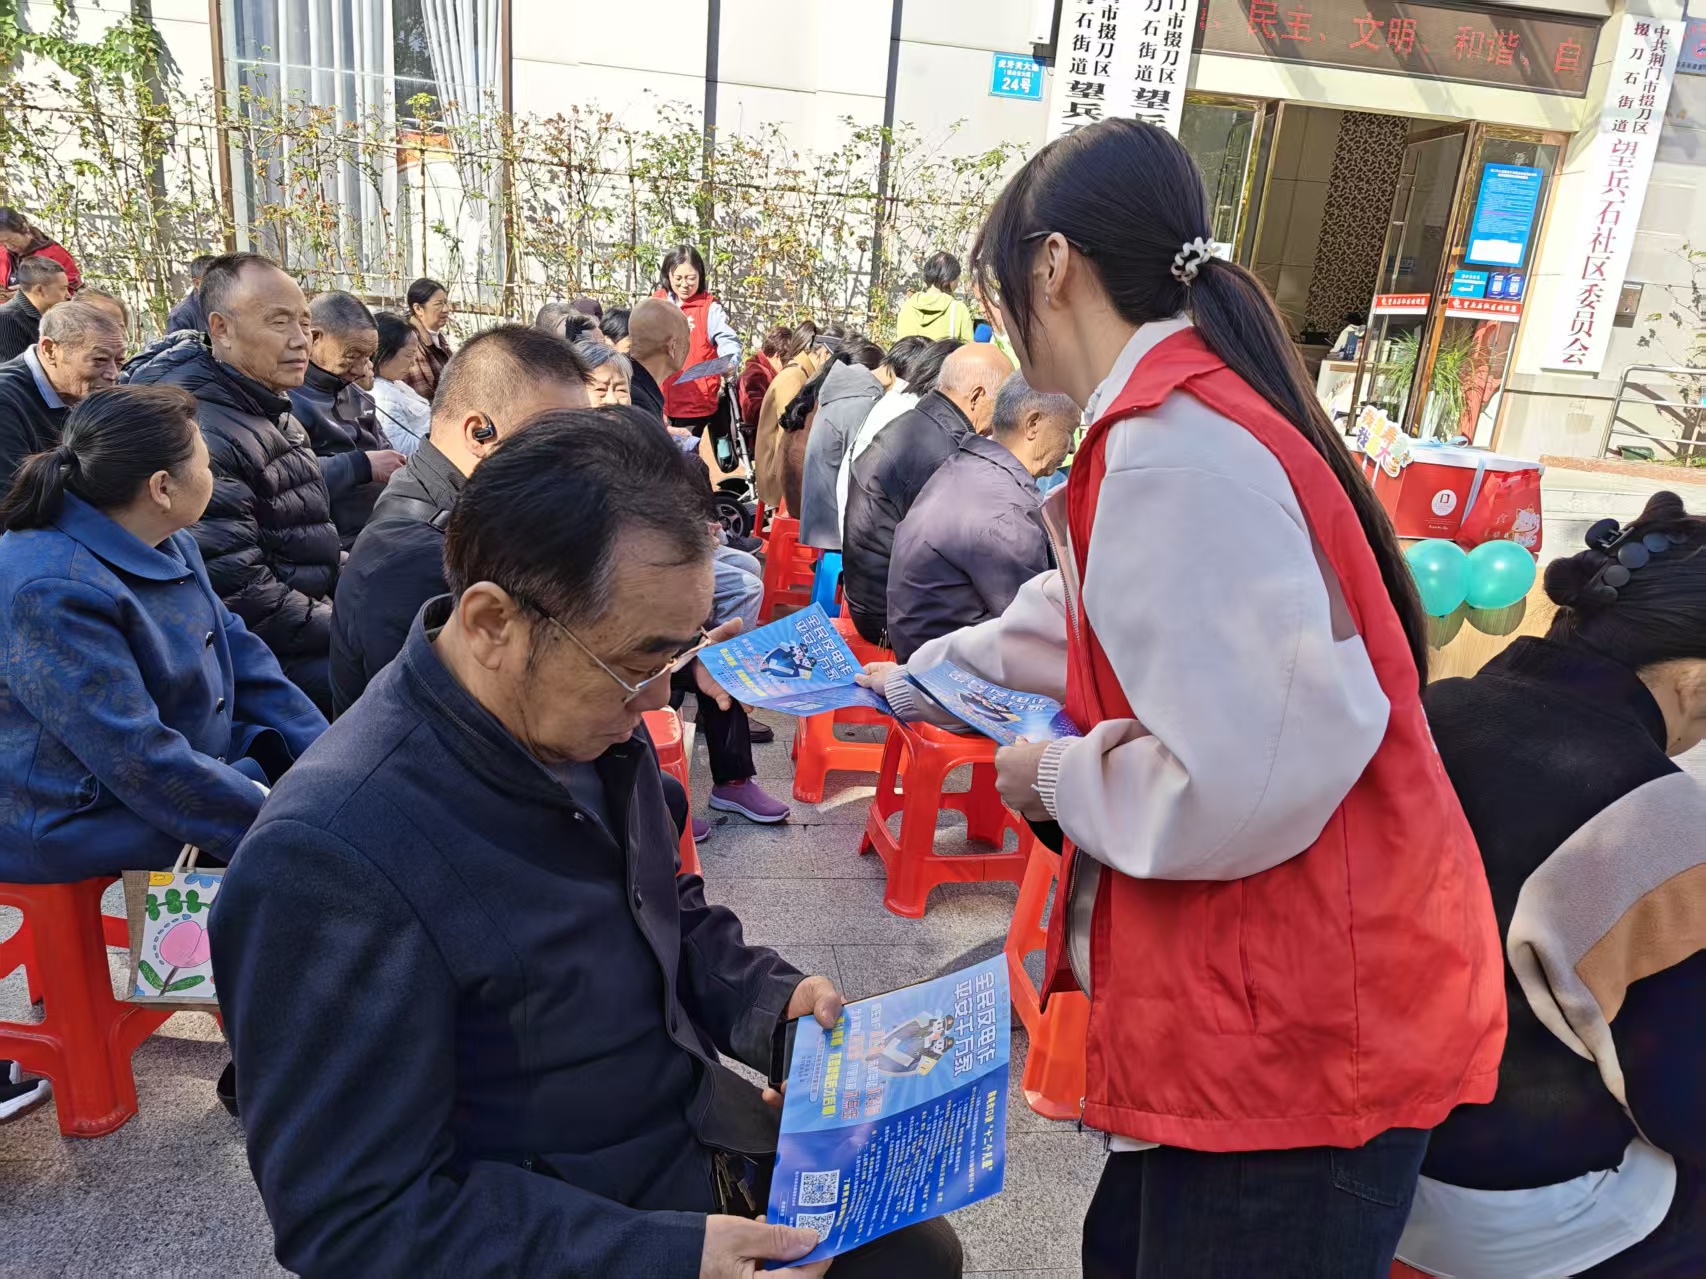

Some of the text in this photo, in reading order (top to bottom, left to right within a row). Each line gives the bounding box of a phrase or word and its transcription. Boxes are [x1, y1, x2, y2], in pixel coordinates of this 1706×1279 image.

[1069, 0, 1094, 75] 石街道
[1093, 0, 1119, 77] 市掇刀区
[1611, 22, 1650, 133] 掇刀石街道
[1632, 25, 1670, 134] 中共荆门市掇刀区
[1001, 76, 1031, 94] 24号
[1562, 138, 1638, 365] 望兵石社区委员会
[794, 619, 841, 682] 平安千万家
[807, 614, 853, 676] 全民反电诈
[953, 979, 976, 1079] 平安千万家
[974, 970, 997, 1066] 全民反电诈
